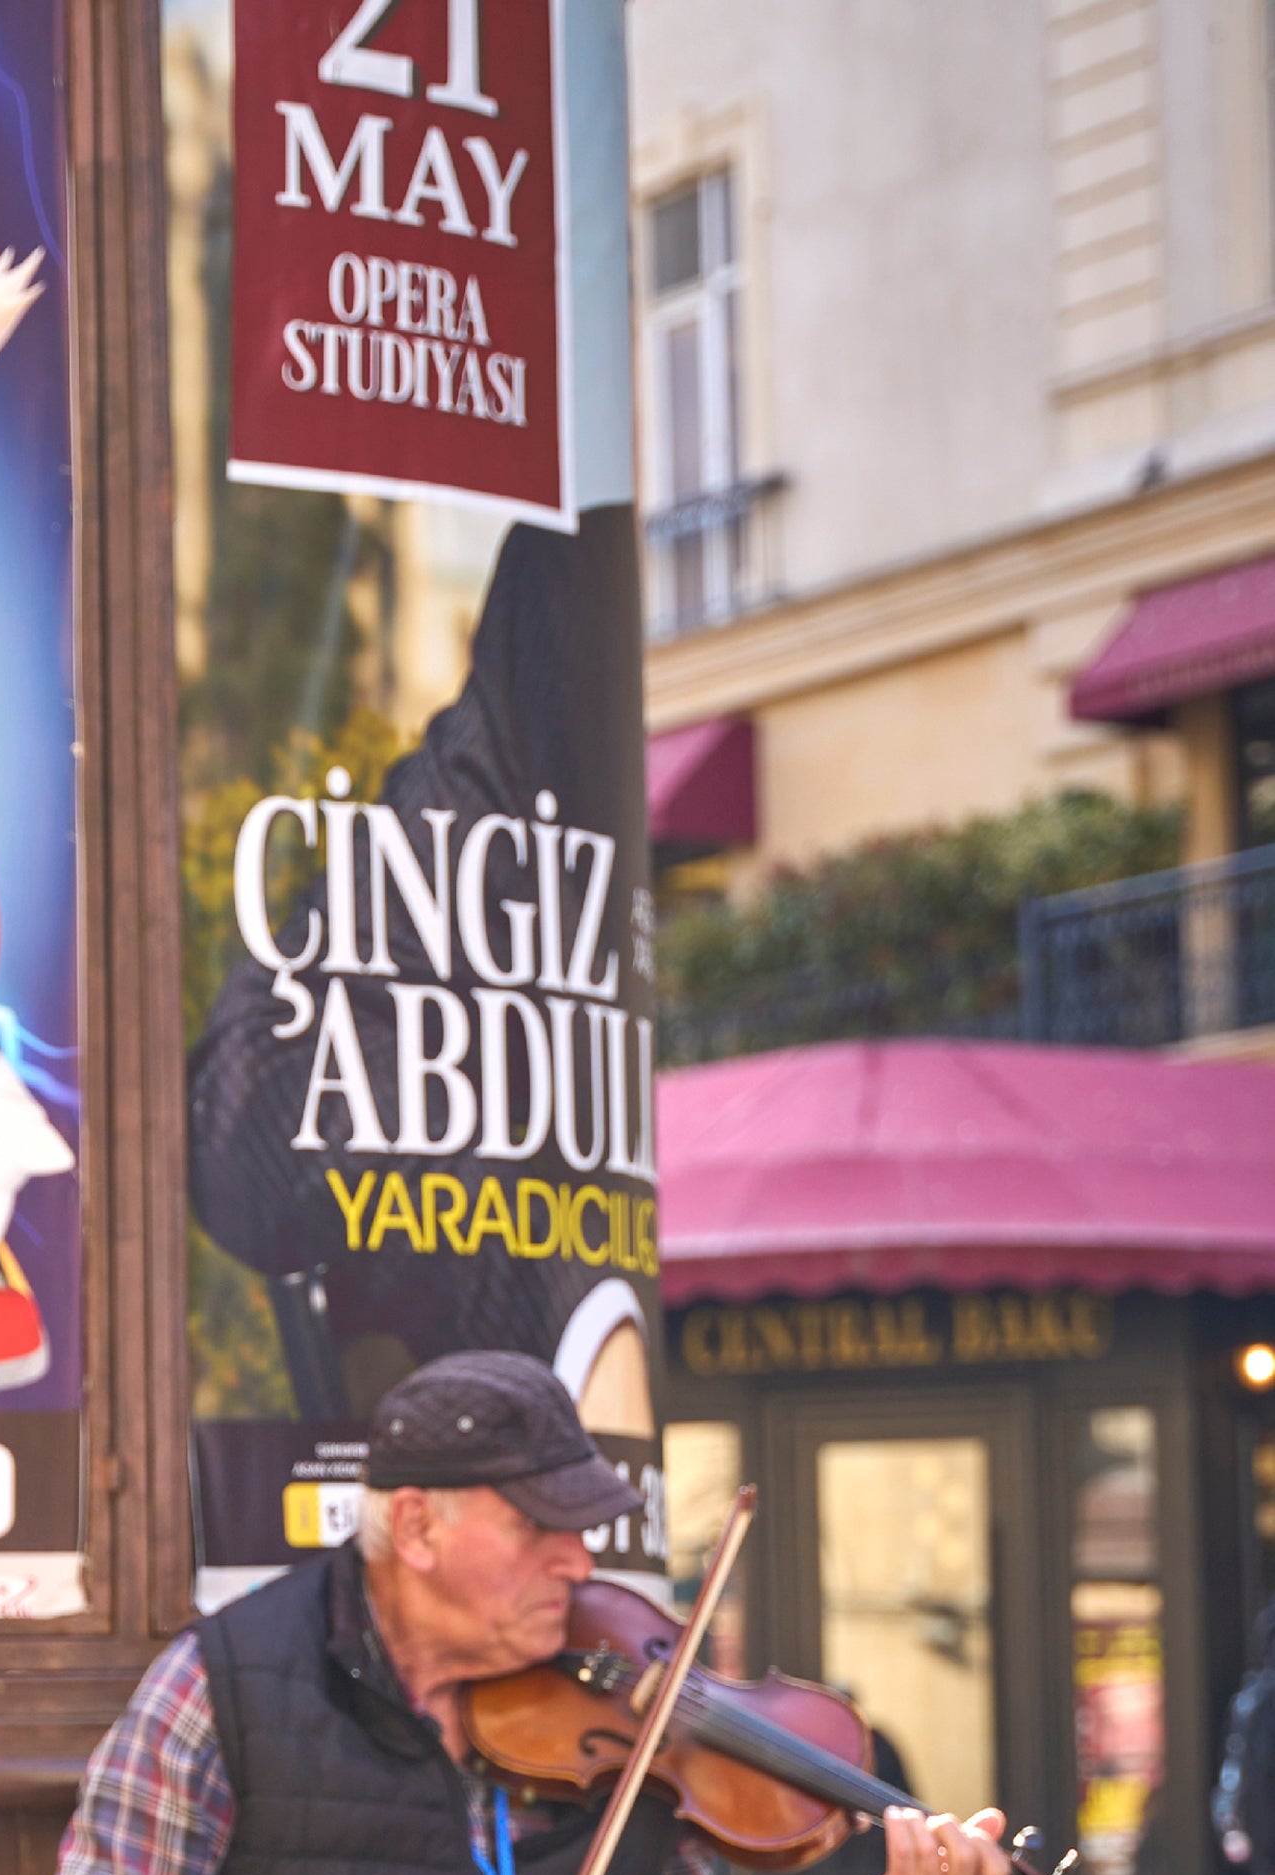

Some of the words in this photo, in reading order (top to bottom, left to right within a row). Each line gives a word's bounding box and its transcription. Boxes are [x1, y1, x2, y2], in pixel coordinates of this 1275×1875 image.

[275, 101, 529, 248] MAY
[328, 251, 491, 346] OPERA
[233, 765, 620, 1039] ÇİNGİZ
